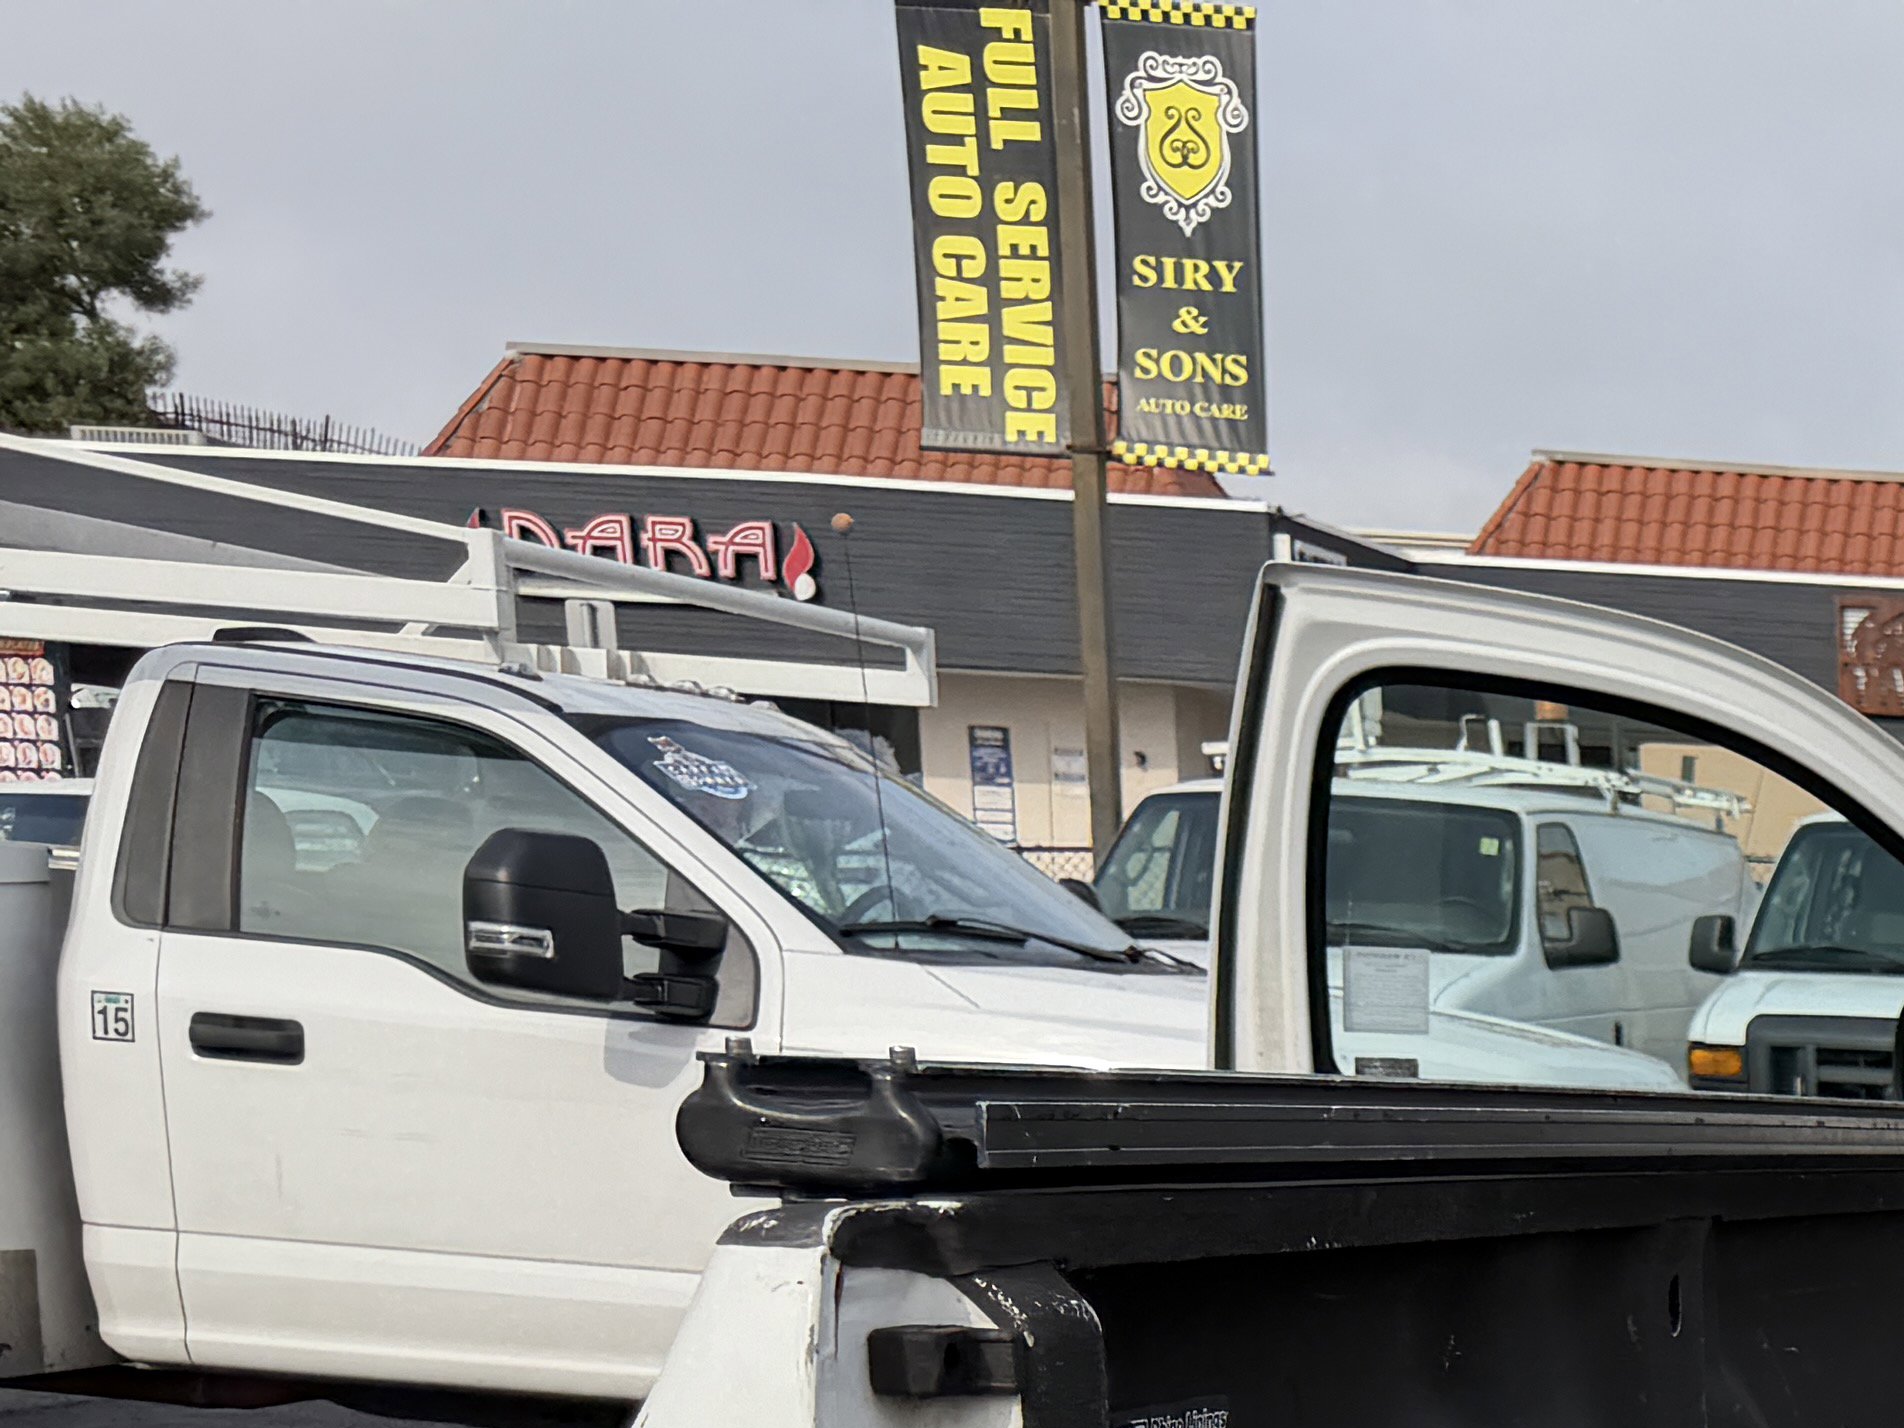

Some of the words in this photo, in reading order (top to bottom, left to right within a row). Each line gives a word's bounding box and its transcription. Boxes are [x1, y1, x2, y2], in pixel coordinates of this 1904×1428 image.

[978, 7, 1041, 150] FULL
[917, 44, 983, 219] AUTO
[1132, 255, 1243, 293] SIRY
[931, 234, 992, 398] CARE
[993, 181, 1058, 444] SERVICE
[1172, 307, 1209, 335] &
[1134, 349, 1249, 387] SONS
[1136, 398, 1190, 416] AUTO
[1193, 401, 1248, 421] CARE
[95, 1005, 130, 1038] 15
